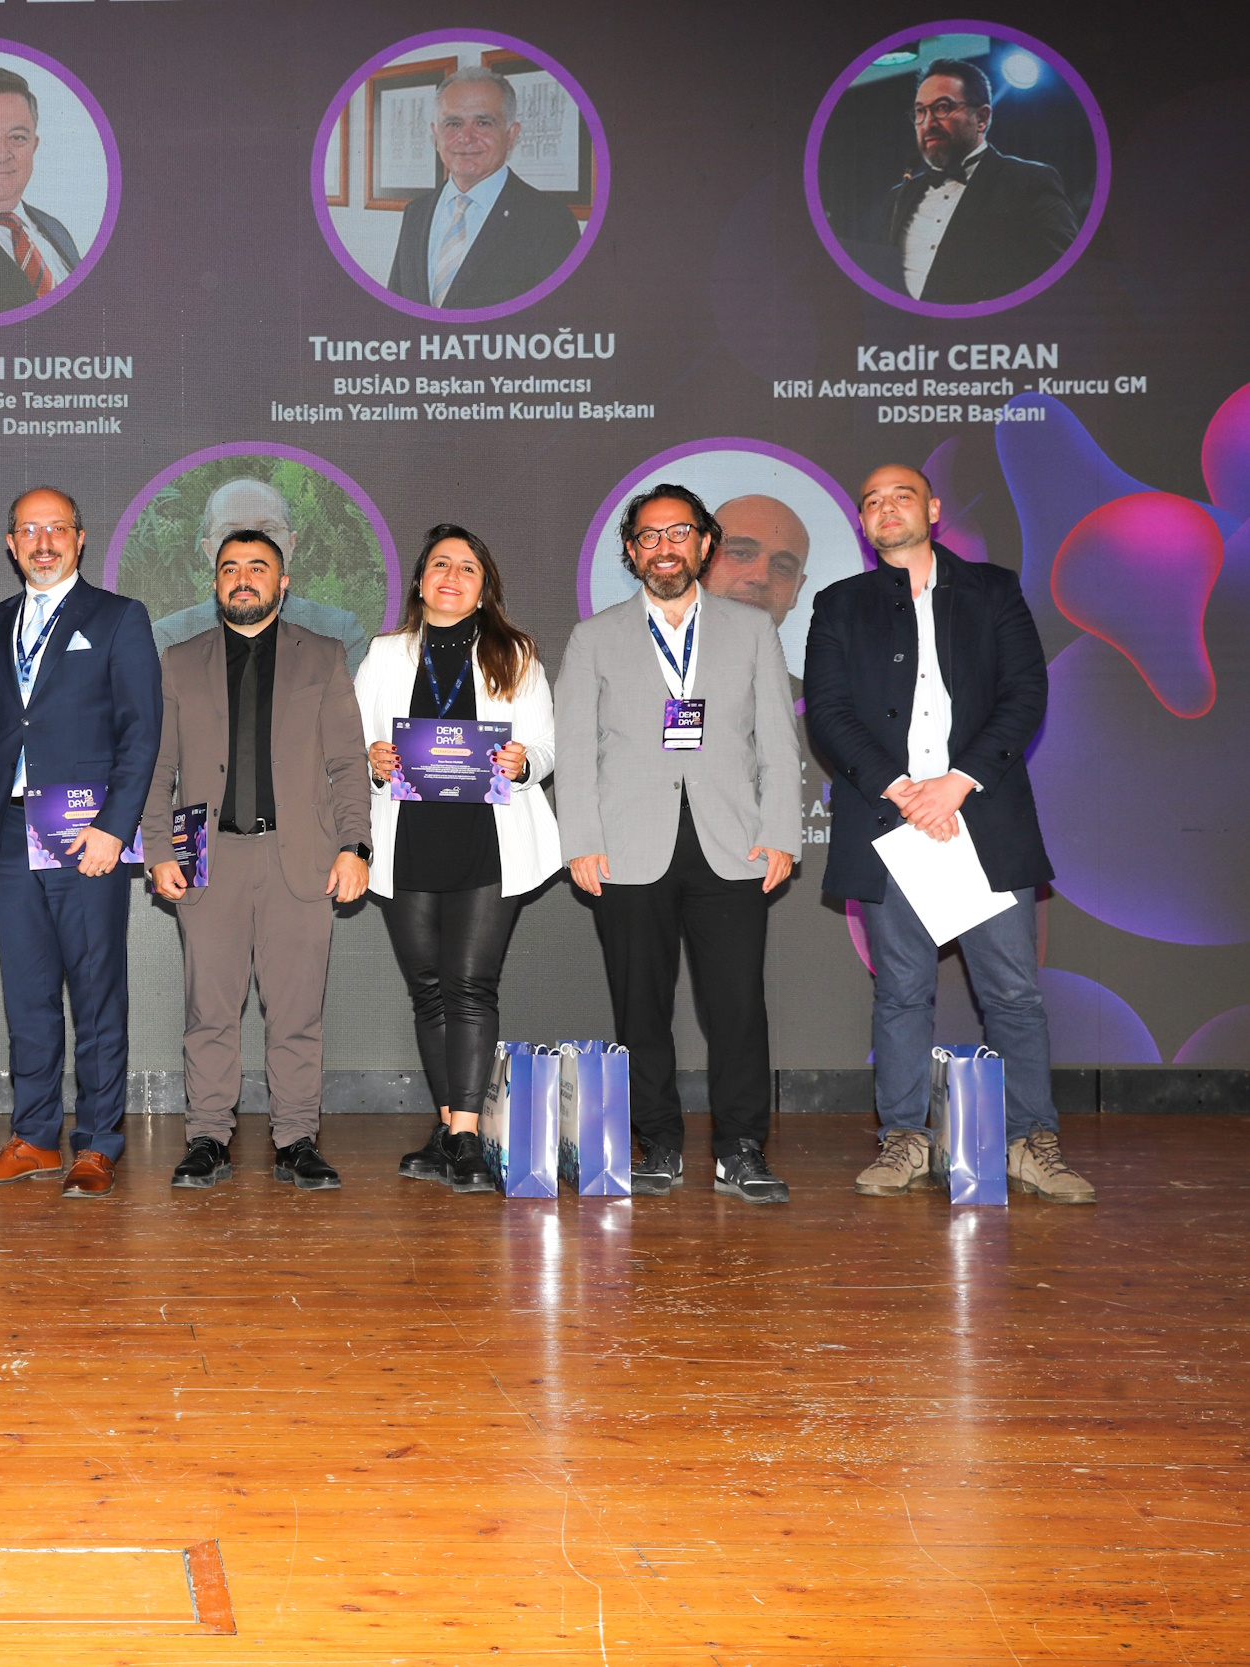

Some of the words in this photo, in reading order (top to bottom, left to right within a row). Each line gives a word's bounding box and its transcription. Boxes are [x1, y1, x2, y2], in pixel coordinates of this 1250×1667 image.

[308, 336, 411, 362] Tuncer
[420, 325, 615, 361] HATUNOĞLU
[13, 356, 133, 380] DURGUN
[857, 344, 940, 372] Kadir
[947, 343, 1058, 371] CERAN
[334, 373, 410, 395] BUSİAD
[415, 376, 485, 397] Başkan
[489, 375, 591, 394] Yardımcısı
[818, 378, 918, 398] Advanced
[923, 377, 1014, 397] Research
[1038, 377, 1109, 395] Kurucu
[1114, 376, 1147, 394] GM
[21, 391, 129, 409] Tasarımcısı
[271, 400, 343, 425] İletişim
[347, 403, 418, 421] Yazılım
[423, 402, 504, 420] Yönetim
[509, 401, 573, 420] Kurulu
[578, 401, 655, 422] Başkanı
[878, 404, 963, 423] DDSDER
[968, 403, 1046, 425] Başkanı
[3, 416, 122, 438] Danışmanlık
[436, 726, 463, 735] DEMO
[436, 736, 455, 745] DAY
[67, 789, 93, 799] DEMO
[68, 799, 87, 808] DAY
